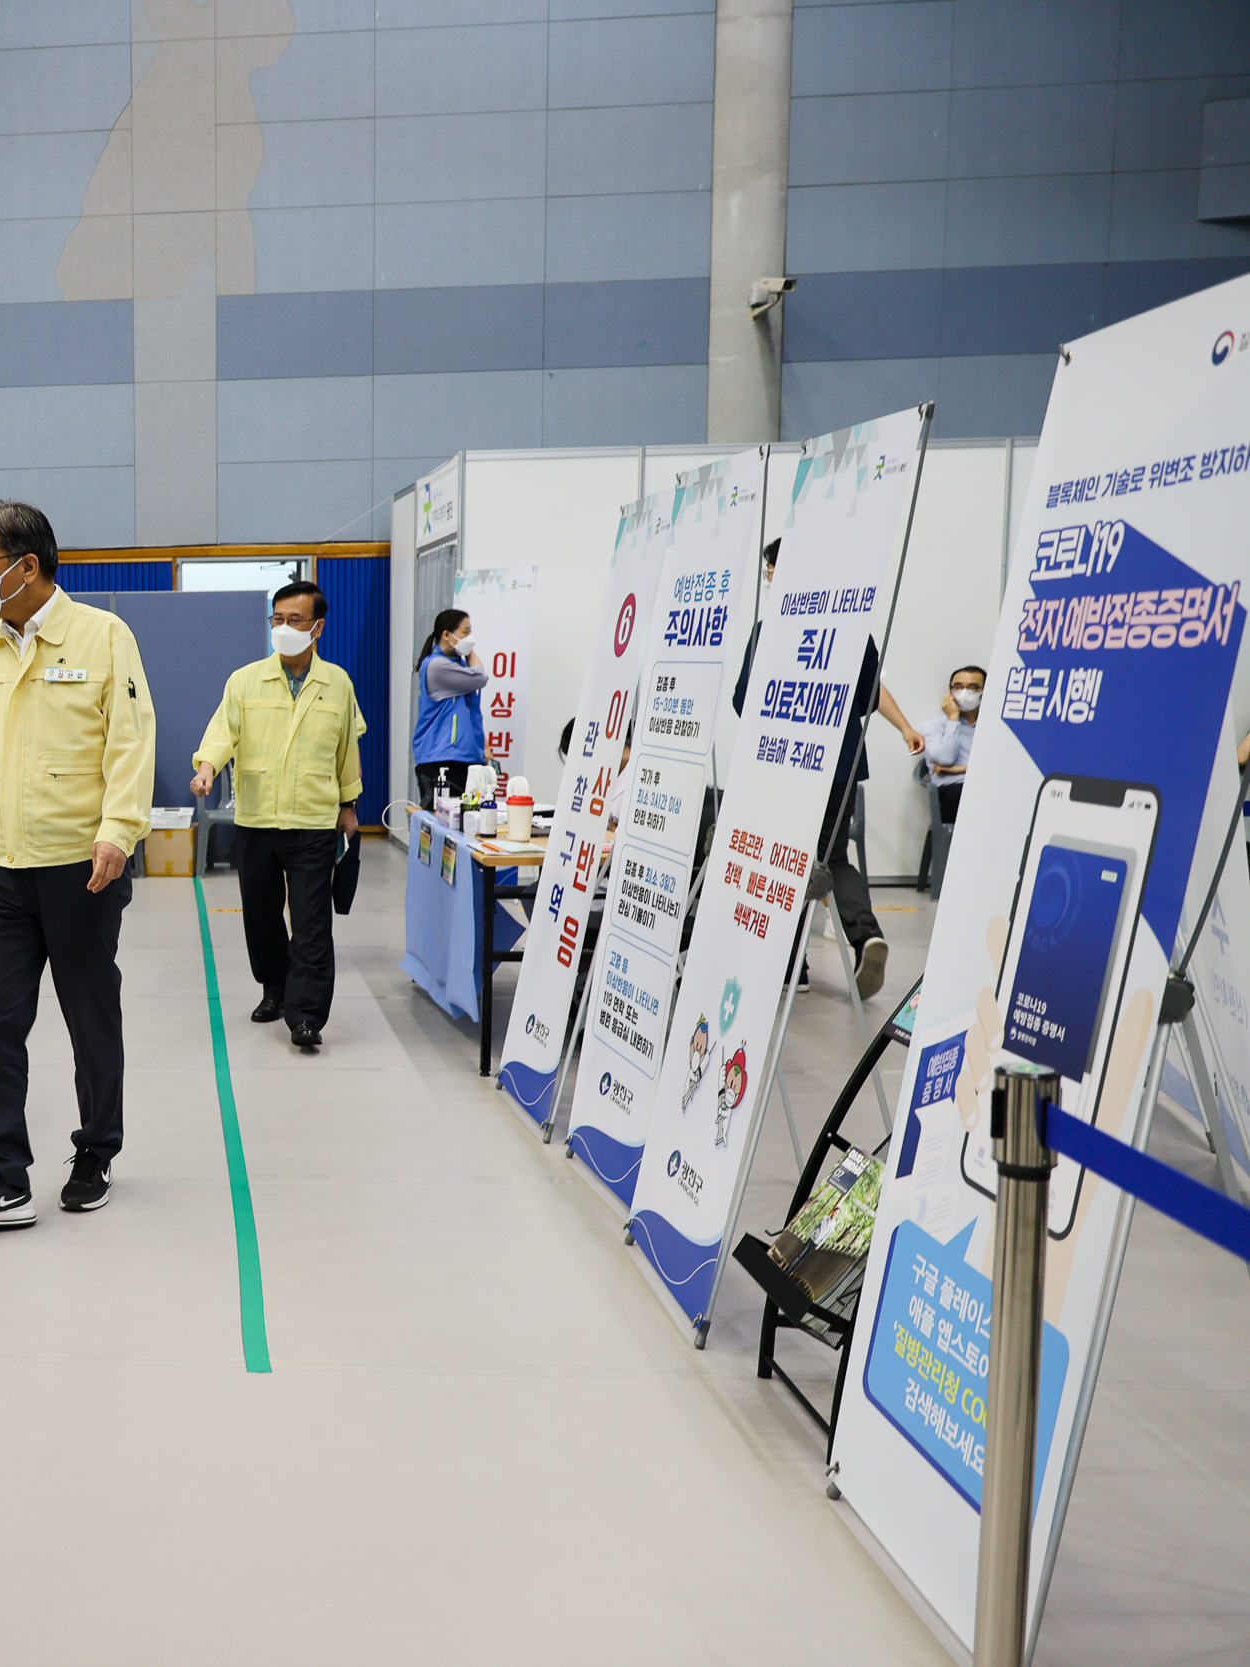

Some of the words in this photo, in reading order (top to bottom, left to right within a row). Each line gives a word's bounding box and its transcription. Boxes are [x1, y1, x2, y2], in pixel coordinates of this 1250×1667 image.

[1045, 474, 1101, 509] 블록체인
[1101, 465, 1146, 498] 기술로
[1148, 454, 1197, 490] 위변조
[1030, 519, 1126, 582] 코로나19
[674, 571, 717, 604] 예방접종
[718, 569, 731, 601] 후
[780, 590, 830, 616] 이상반응이
[831, 586, 877, 614] 나타나면
[618, 604, 633, 646] 6
[664, 605, 729, 648] 주의사항
[1017, 598, 1066, 651] 전자
[1061, 581, 1241, 651] 예방접종증명서
[796, 627, 837, 671] 즉시
[656, 676, 670, 693] 접종
[669, 676, 677, 693] 후
[1001, 667, 1051, 721] 발급
[1046, 667, 1104, 724] 시행!
[652, 697, 680, 715] 15~30분
[680, 698, 694, 715] 동안
[760, 679, 850, 728] 의료진에게
[649, 716, 673, 735] 이상반응
[673, 718, 701, 739] 관찰하기
[757, 735, 790, 765] 말씀해
[790, 741, 825, 772] 주세요.
[640, 768, 653, 786] 귀가
[654, 770, 661, 787] 후
[633, 808, 647, 826] 안정
[646, 811, 666, 832] 취하기
[636, 788, 649, 806] 최소
[650, 791, 668, 811] 3시간
[668, 795, 682, 815] 이상
[728, 828, 764, 863] 호흡곤란,
[769, 841, 809, 878] 어지러움
[624, 859, 638, 878] 접종
[637, 865, 645, 880] 후
[644, 867, 658, 886] 최소
[659, 873, 677, 894] 3일간
[724, 861, 744, 891] 창백,
[746, 870, 768, 899] 빠른
[765, 879, 797, 913] 심박동
[617, 899, 631, 918] 관심
[630, 904, 657, 931] 기울이기
[621, 879, 652, 906] 이상반응이
[651, 892, 681, 920] 나타나는지
[608, 950, 622, 971] 고열
[621, 957, 629, 975] 등
[603, 989, 613, 1008] 119
[612, 995, 626, 1017] 연락
[624, 1003, 640, 1027] 또는
[606, 970, 636, 1001] 이상반응이
[635, 986, 660, 1017] 나타나면
[1015, 992, 1048, 1016] 코로나19
[599, 1008, 612, 1031] 병원
[611, 1016, 629, 1043] 응급실
[629, 1029, 655, 1061] 내원하기
[1012, 1008, 1042, 1033] 예방접종
[1041, 1019, 1066, 1043] 증명서
[612, 1078, 634, 1106] 광진구
[682, 1160, 704, 1194] 광진구
[911, 1253, 940, 1298] 구글
[908, 1294, 937, 1339] 애플
